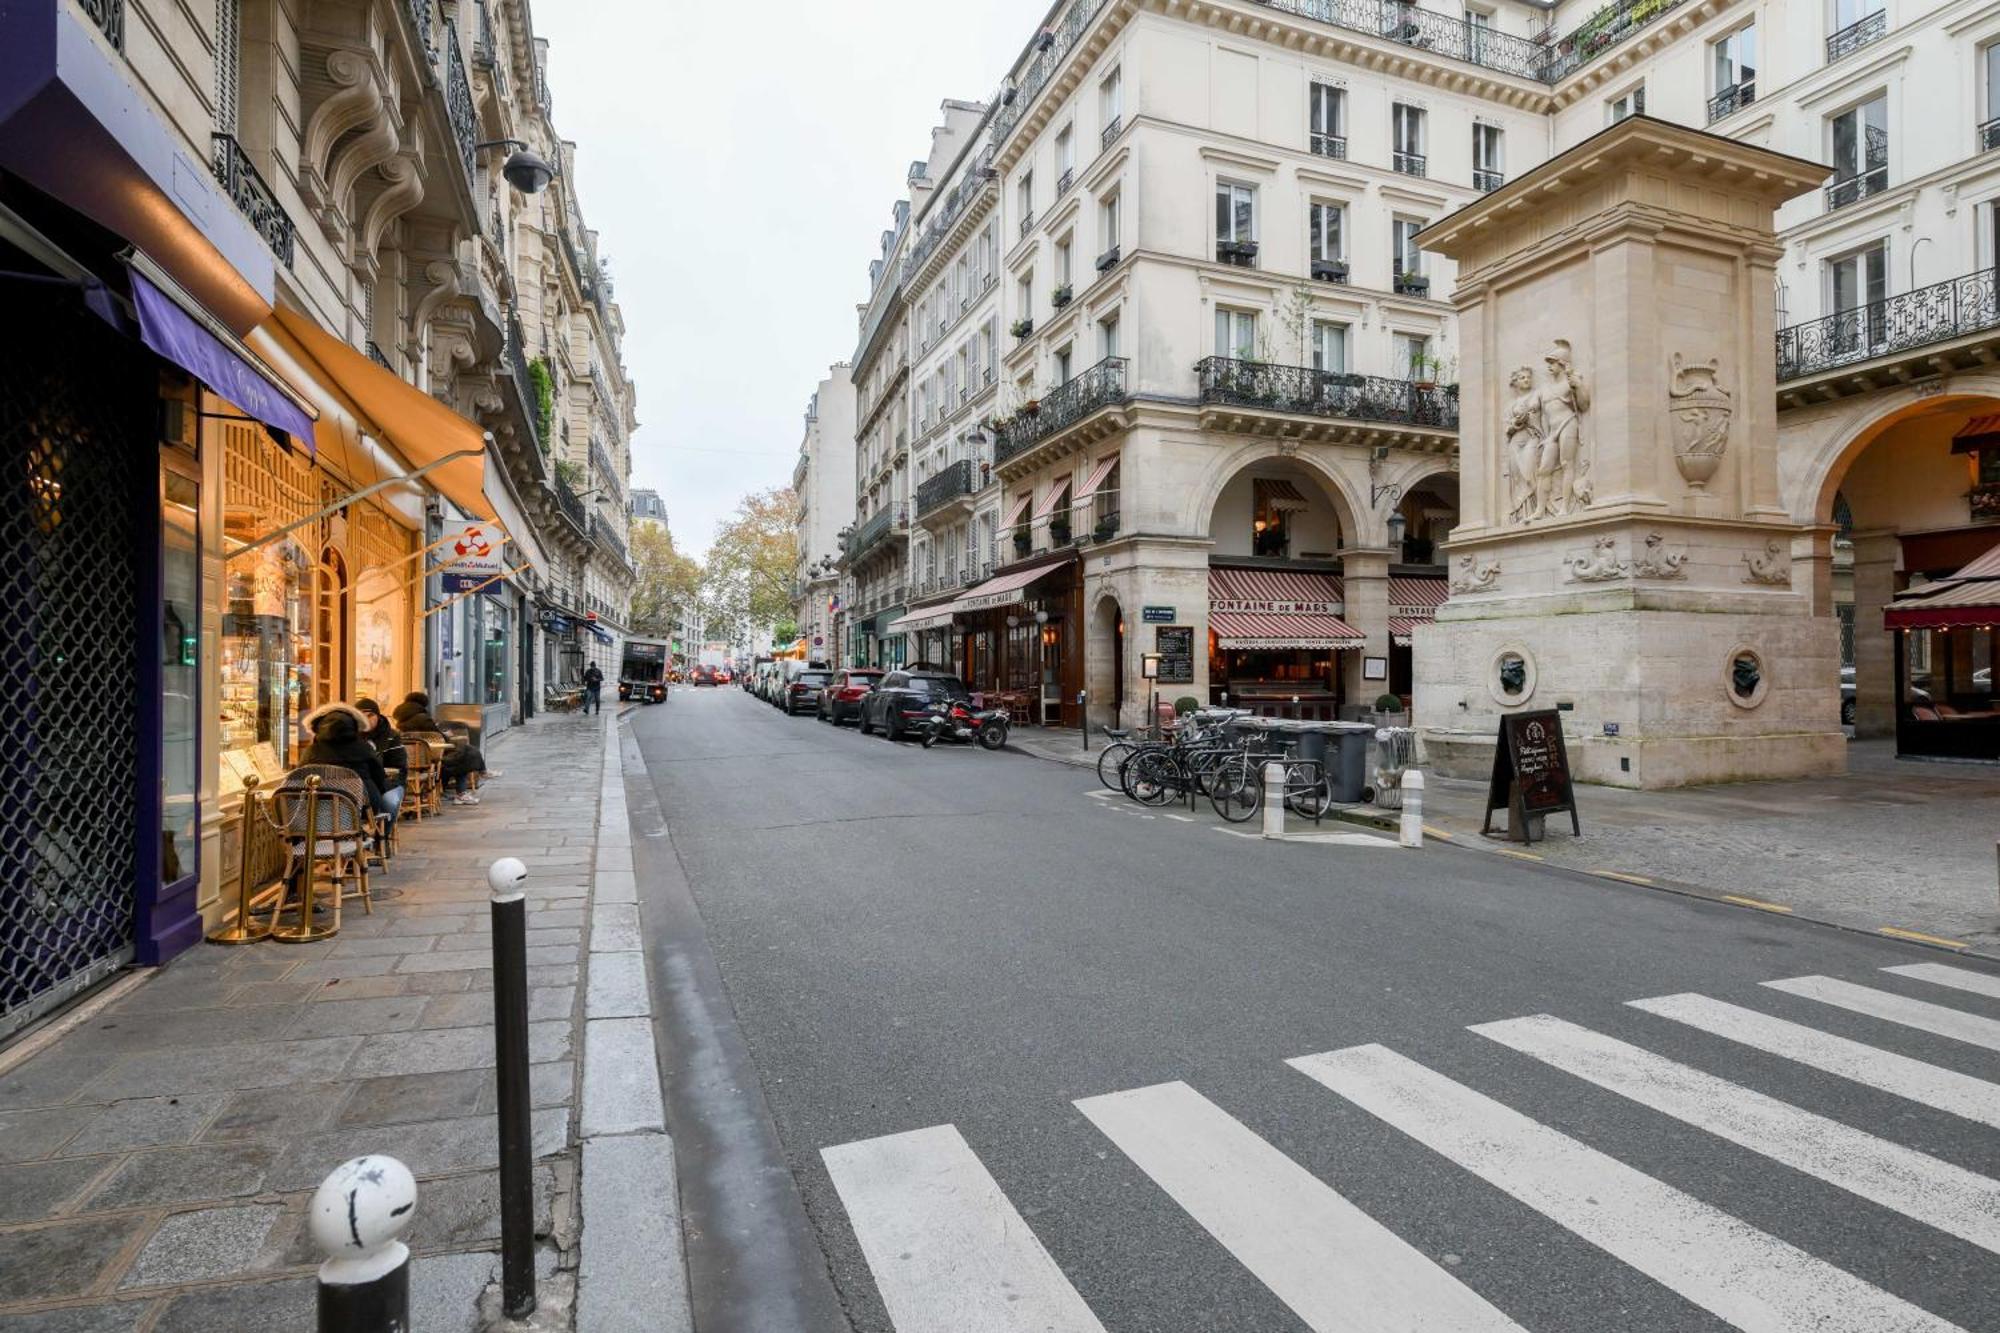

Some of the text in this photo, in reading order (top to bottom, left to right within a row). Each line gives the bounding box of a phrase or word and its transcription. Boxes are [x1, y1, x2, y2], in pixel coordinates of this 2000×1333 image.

[1209, 600, 1329, 613] FONTAINE DE MARS
